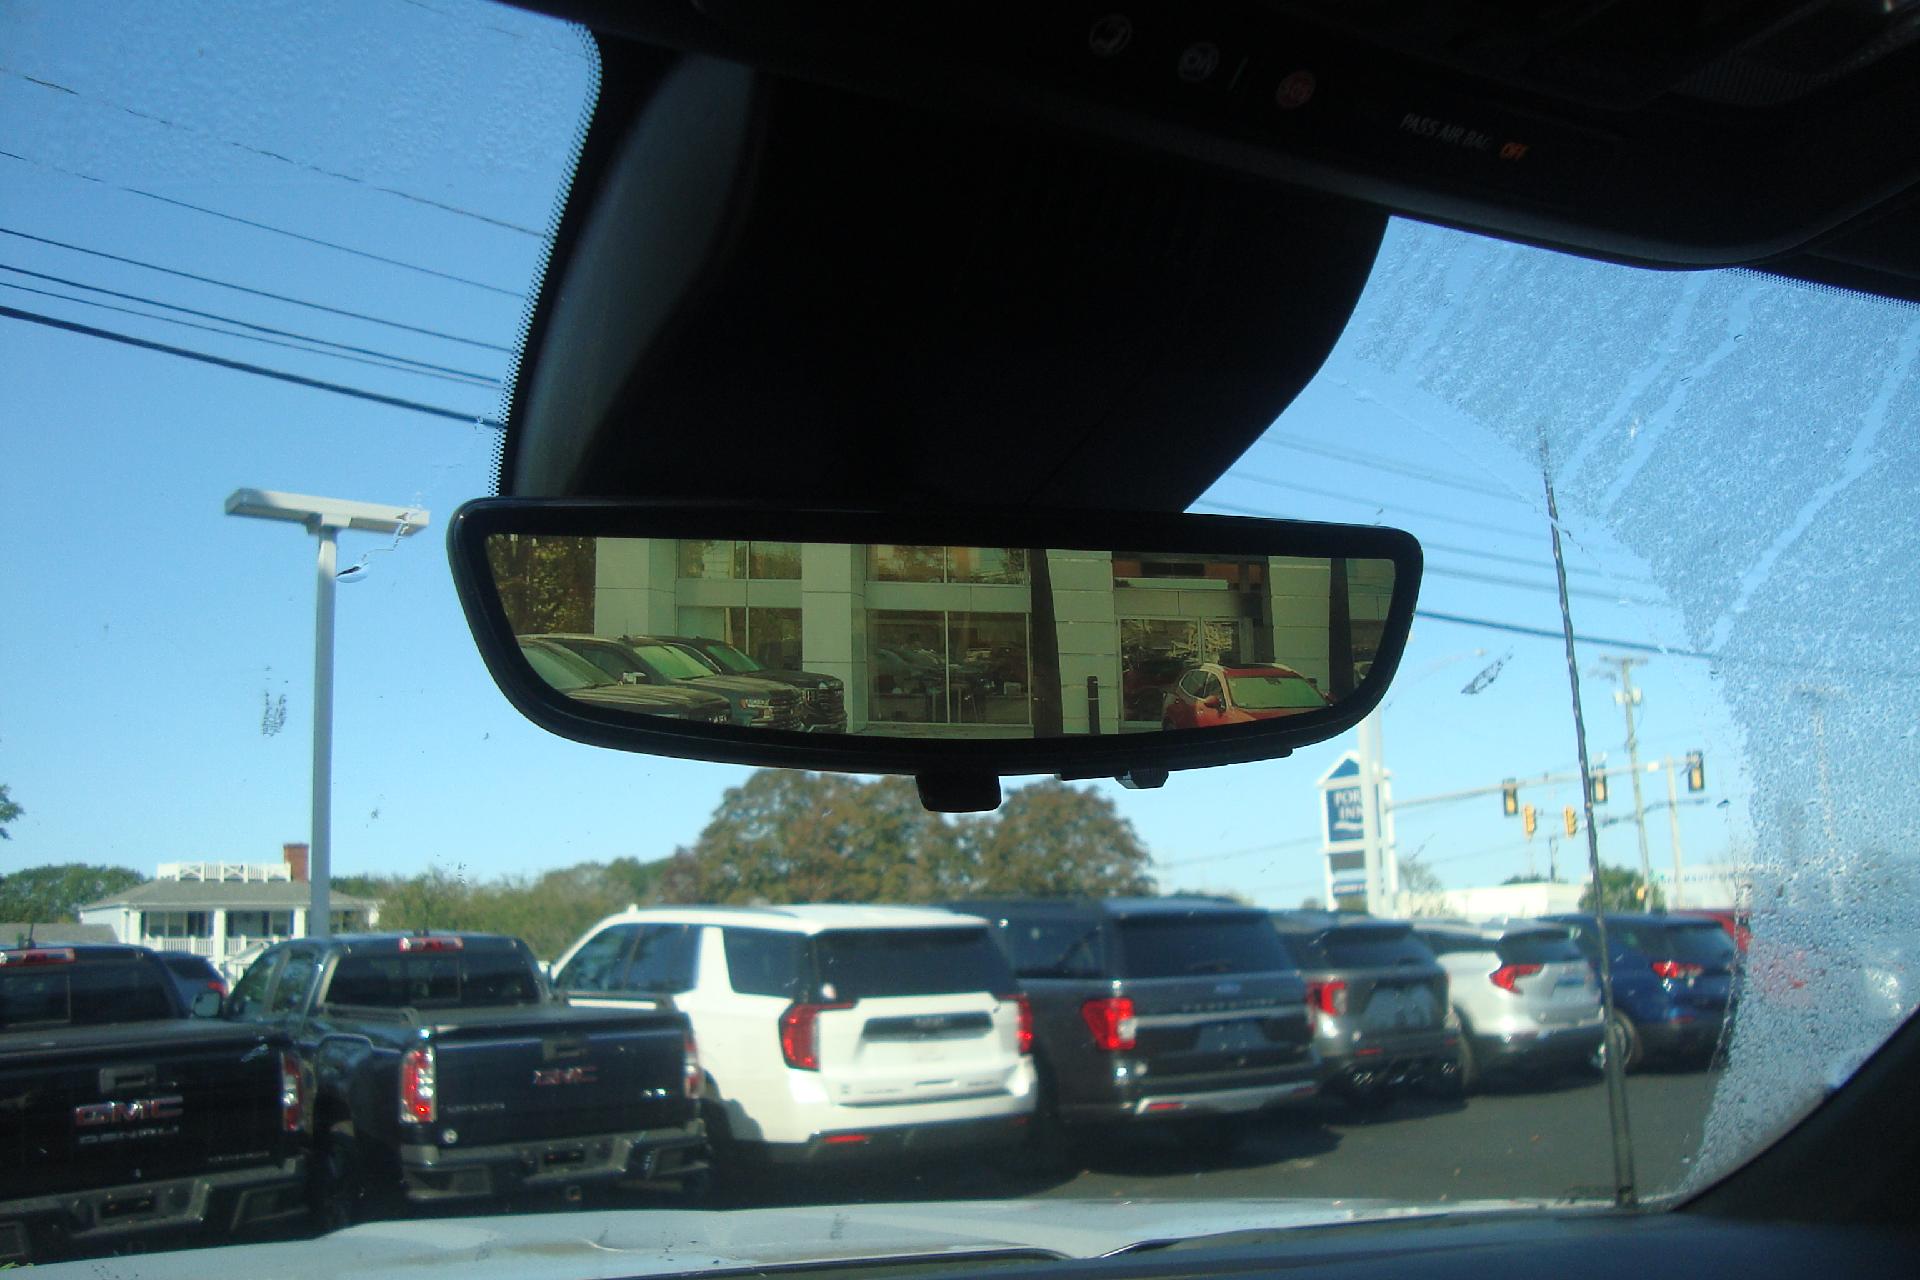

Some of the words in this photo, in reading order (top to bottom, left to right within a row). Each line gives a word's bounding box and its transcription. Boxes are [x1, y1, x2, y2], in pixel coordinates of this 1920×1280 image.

[1400, 112, 1440, 136] PASS
[1439, 124, 1464, 144] AIR
[1335, 787, 1361, 806] POR
[75, 1096, 183, 1126] GMC
